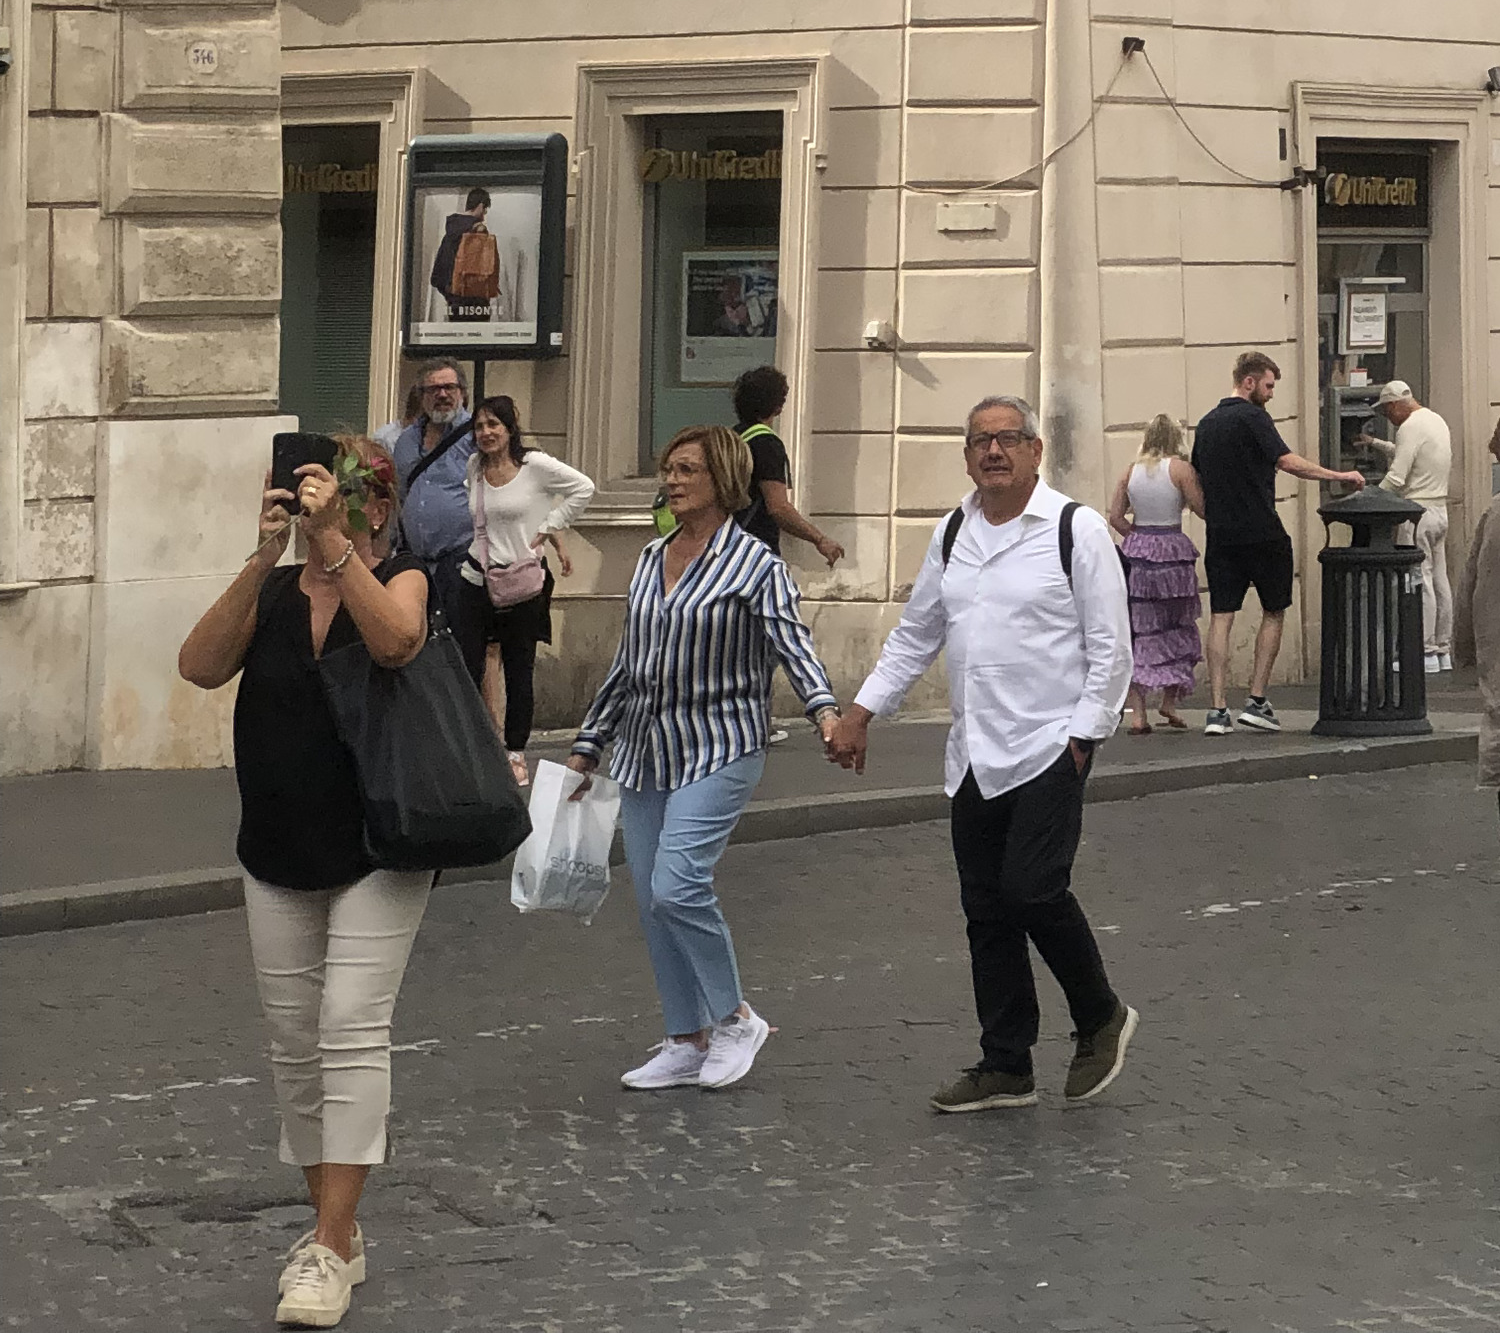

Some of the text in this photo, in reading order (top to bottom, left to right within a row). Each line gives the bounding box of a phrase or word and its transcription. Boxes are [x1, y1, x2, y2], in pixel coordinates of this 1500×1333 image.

[283, 163, 378, 192] UniCredi
[672, 149, 783, 178] UniCredi
[1352, 176, 1417, 206] UniCredit
[458, 305, 504, 316] BISONTE
